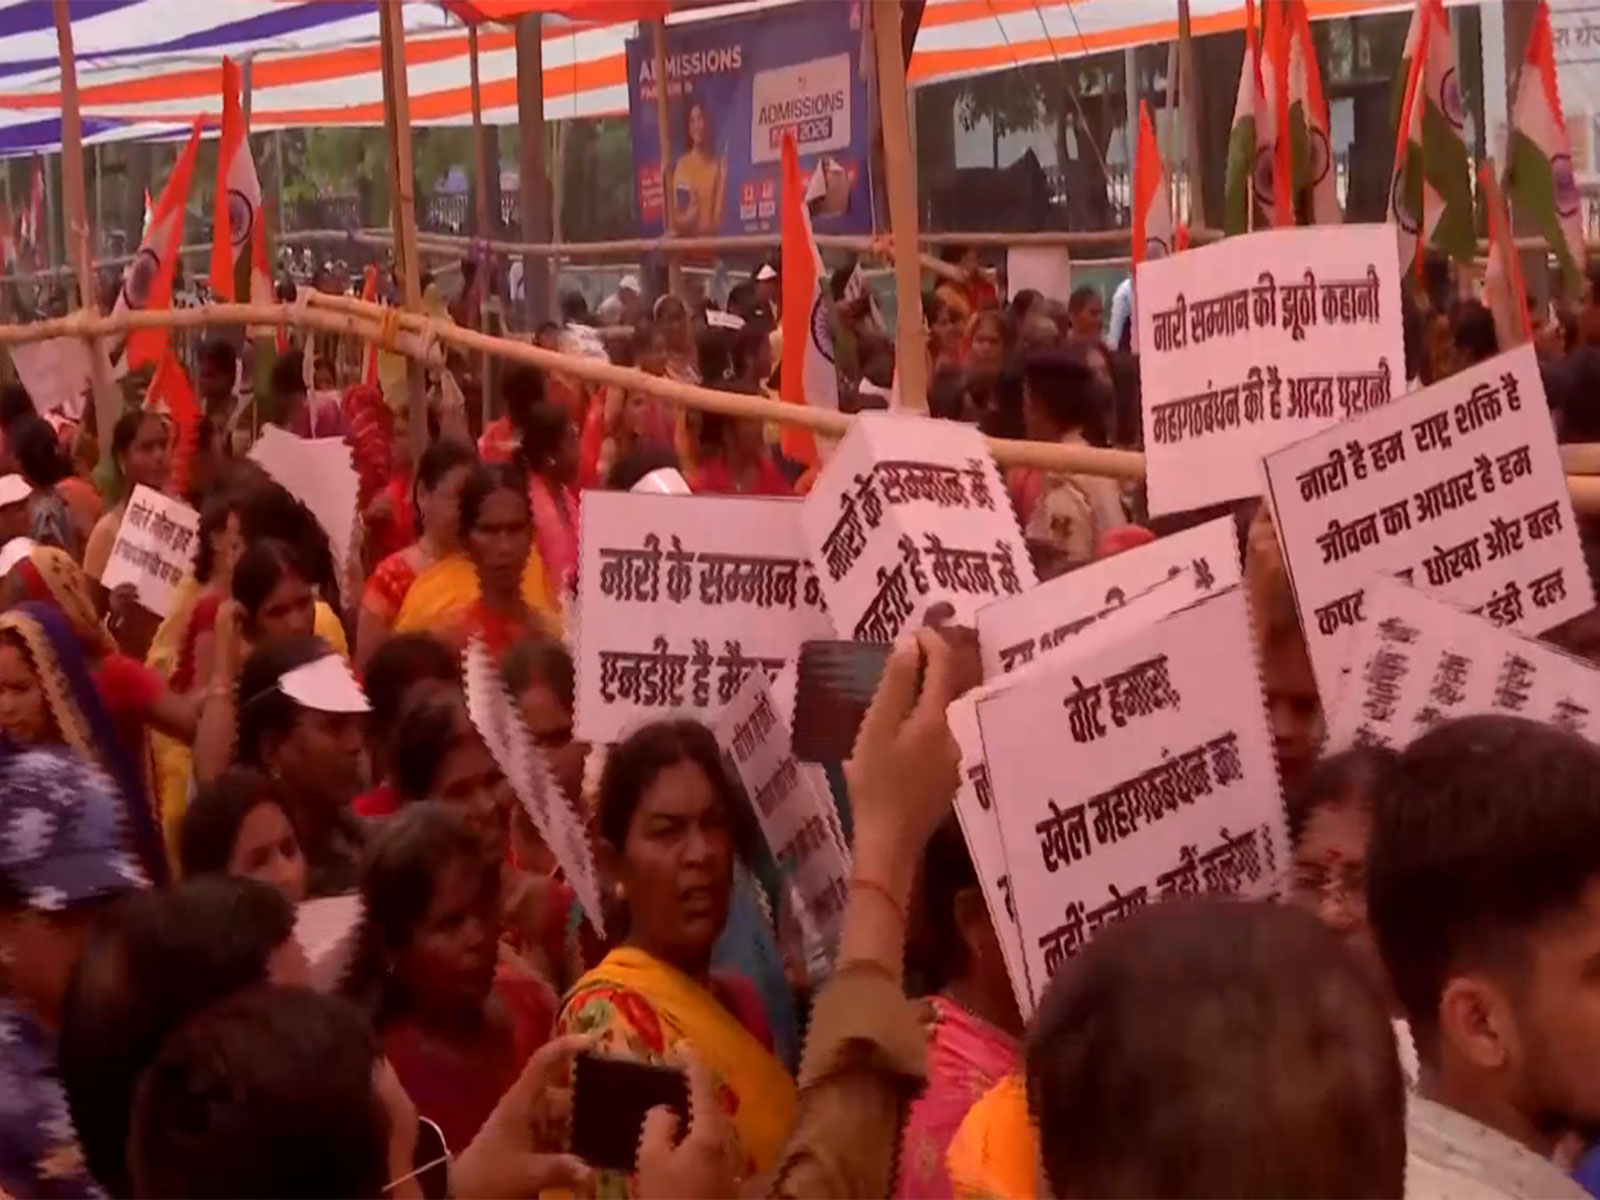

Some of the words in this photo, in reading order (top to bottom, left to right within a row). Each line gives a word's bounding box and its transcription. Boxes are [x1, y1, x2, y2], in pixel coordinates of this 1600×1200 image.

[758, 90, 844, 125] ADMISSIONS
[800, 118, 830, 140] 2026
[1152, 292, 1187, 352] नारी
[1190, 288, 1250, 343] सम्मान
[1252, 272, 1277, 328] की
[1280, 267, 1317, 342] झूठी
[1320, 264, 1381, 325] कहानी
[1151, 380, 1241, 444] महागठबंधन
[1241, 366, 1264, 423] की
[1266, 365, 1283, 421] है
[1287, 377, 1334, 418] आदत
[1296, 450, 1348, 502] नारी
[1347, 441, 1368, 480] है
[1368, 430, 1406, 471] हम
[1411, 410, 1453, 452] राष्ट्र
[1455, 383, 1502, 435] शक्ति
[1501, 373, 1522, 411] है
[820, 489, 868, 582] नारी
[853, 474, 884, 529] के
[873, 461, 971, 510] सम्मान
[961, 458, 996, 512] में
[1316, 513, 1380, 564] जीवन
[1380, 499, 1411, 536] का
[1413, 470, 1477, 523] आधार
[1474, 455, 1496, 493] है
[1496, 445, 1533, 485] हम
[599, 533, 663, 602] नारी
[665, 534, 696, 603] के
[698, 552, 802, 611] सम्मान
[898, 532, 931, 595] है
[922, 532, 999, 596] मैदान
[991, 539, 1024, 595] में
[1315, 589, 1368, 636] कपट
[1423, 538, 1482, 586] धोखा
[1484, 517, 1524, 561] और
[1524, 501, 1564, 540] बल
[1528, 568, 1568, 608] दल
[599, 634, 690, 708] एनडीए
[691, 638, 715, 708] है
[1063, 675, 1106, 743] वोट
[1035, 798, 1091, 873] खेल
[1088, 744, 1213, 844] महागठबंधन
[1205, 730, 1244, 787] का
